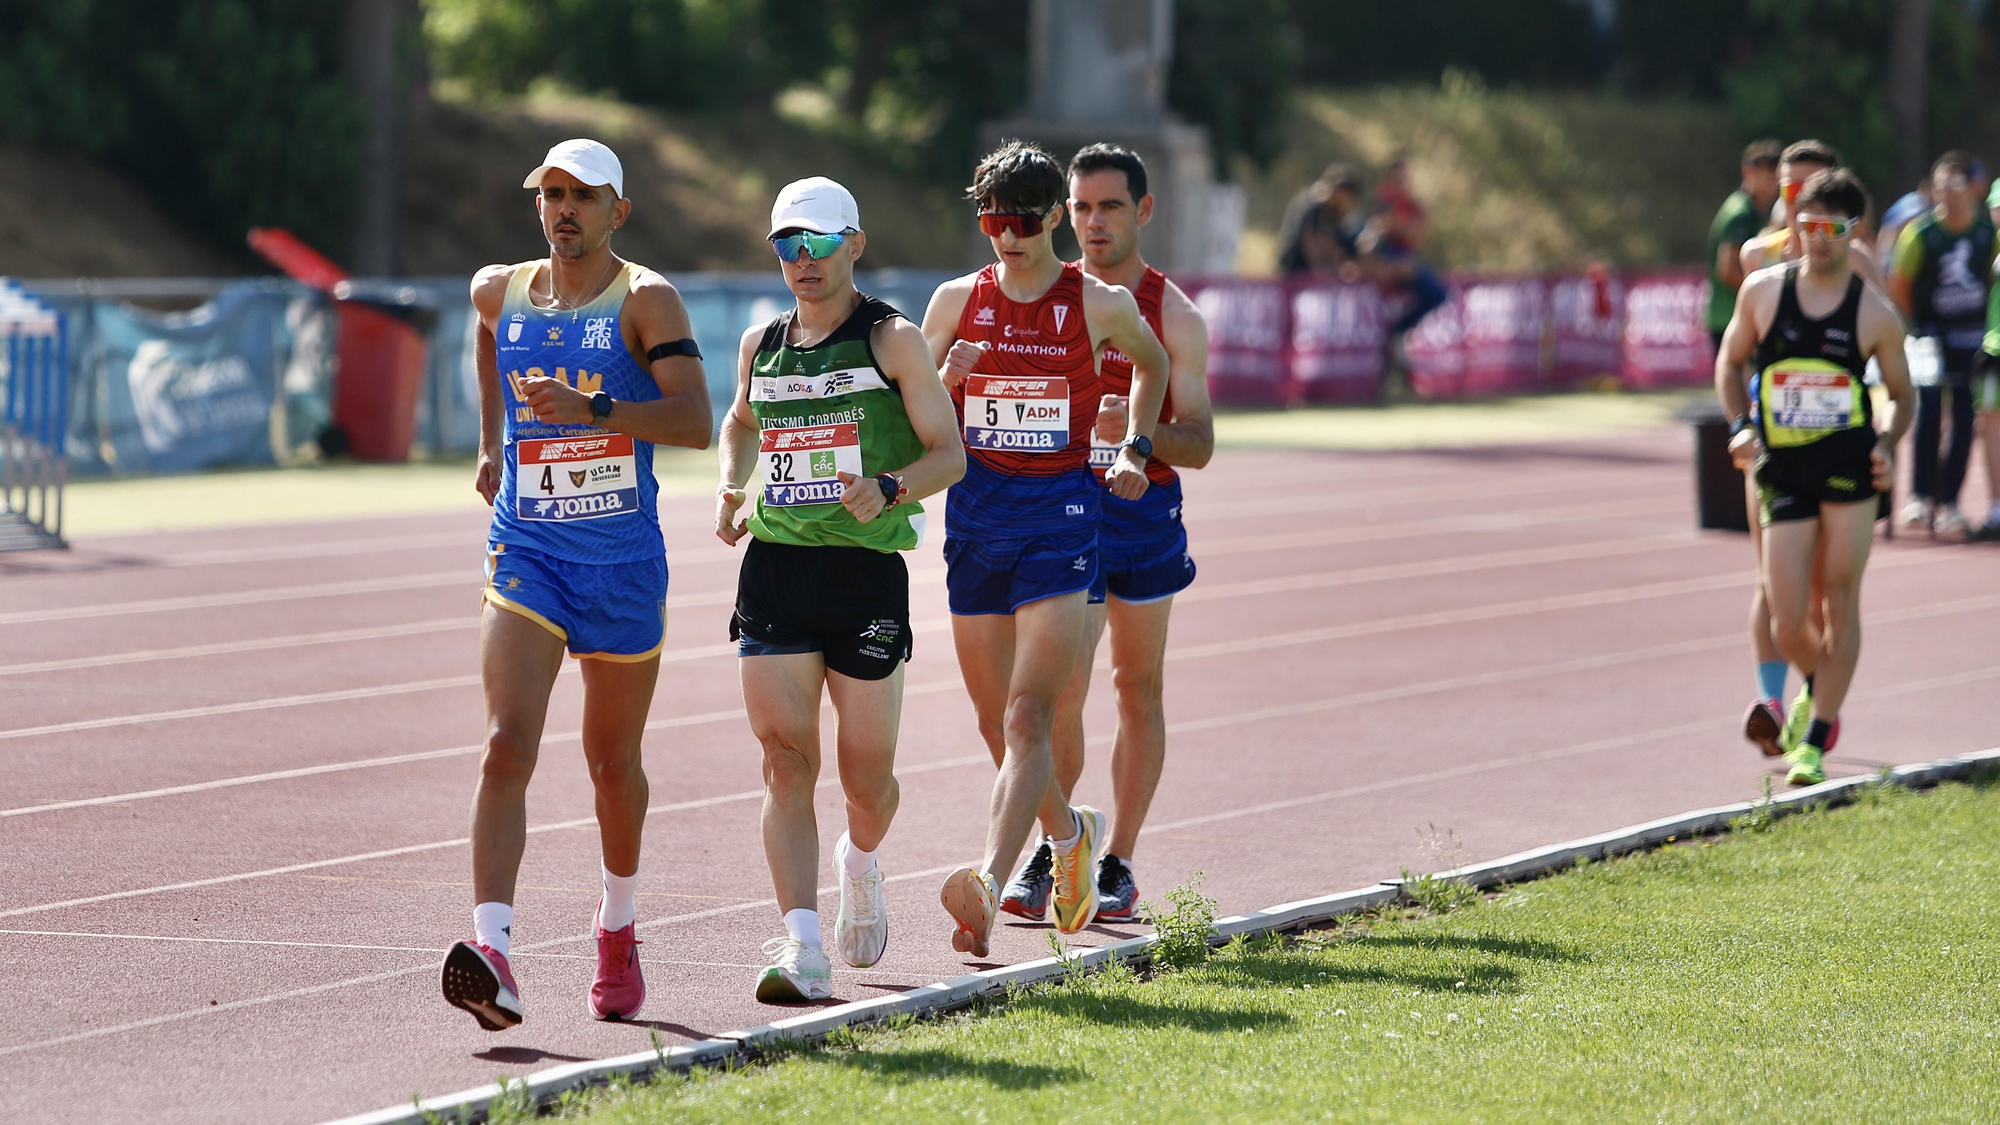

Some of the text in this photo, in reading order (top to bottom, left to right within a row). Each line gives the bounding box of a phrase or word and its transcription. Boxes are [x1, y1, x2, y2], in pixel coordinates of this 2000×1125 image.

[997, 342, 1067, 356] MARATHON
[1005, 381, 1049, 391] RFEA
[809, 406, 866, 426] CORDOBÉS
[986, 399, 998, 427] 5
[1026, 407, 1060, 418] ADM
[516, 426, 610, 437] Atletismo Cartagena
[791, 428, 836, 443] RFEA
[563, 439, 609, 453] RFEA
[790, 439, 833, 448] ATLETISMO
[561, 449, 606, 459] ATLETISMO
[590, 464, 622, 477] UCAM
[770, 452, 795, 483] 32
[813, 462, 834, 471] CAC
[540, 464, 555, 496] 4
[875, 634, 894, 643] CAC
